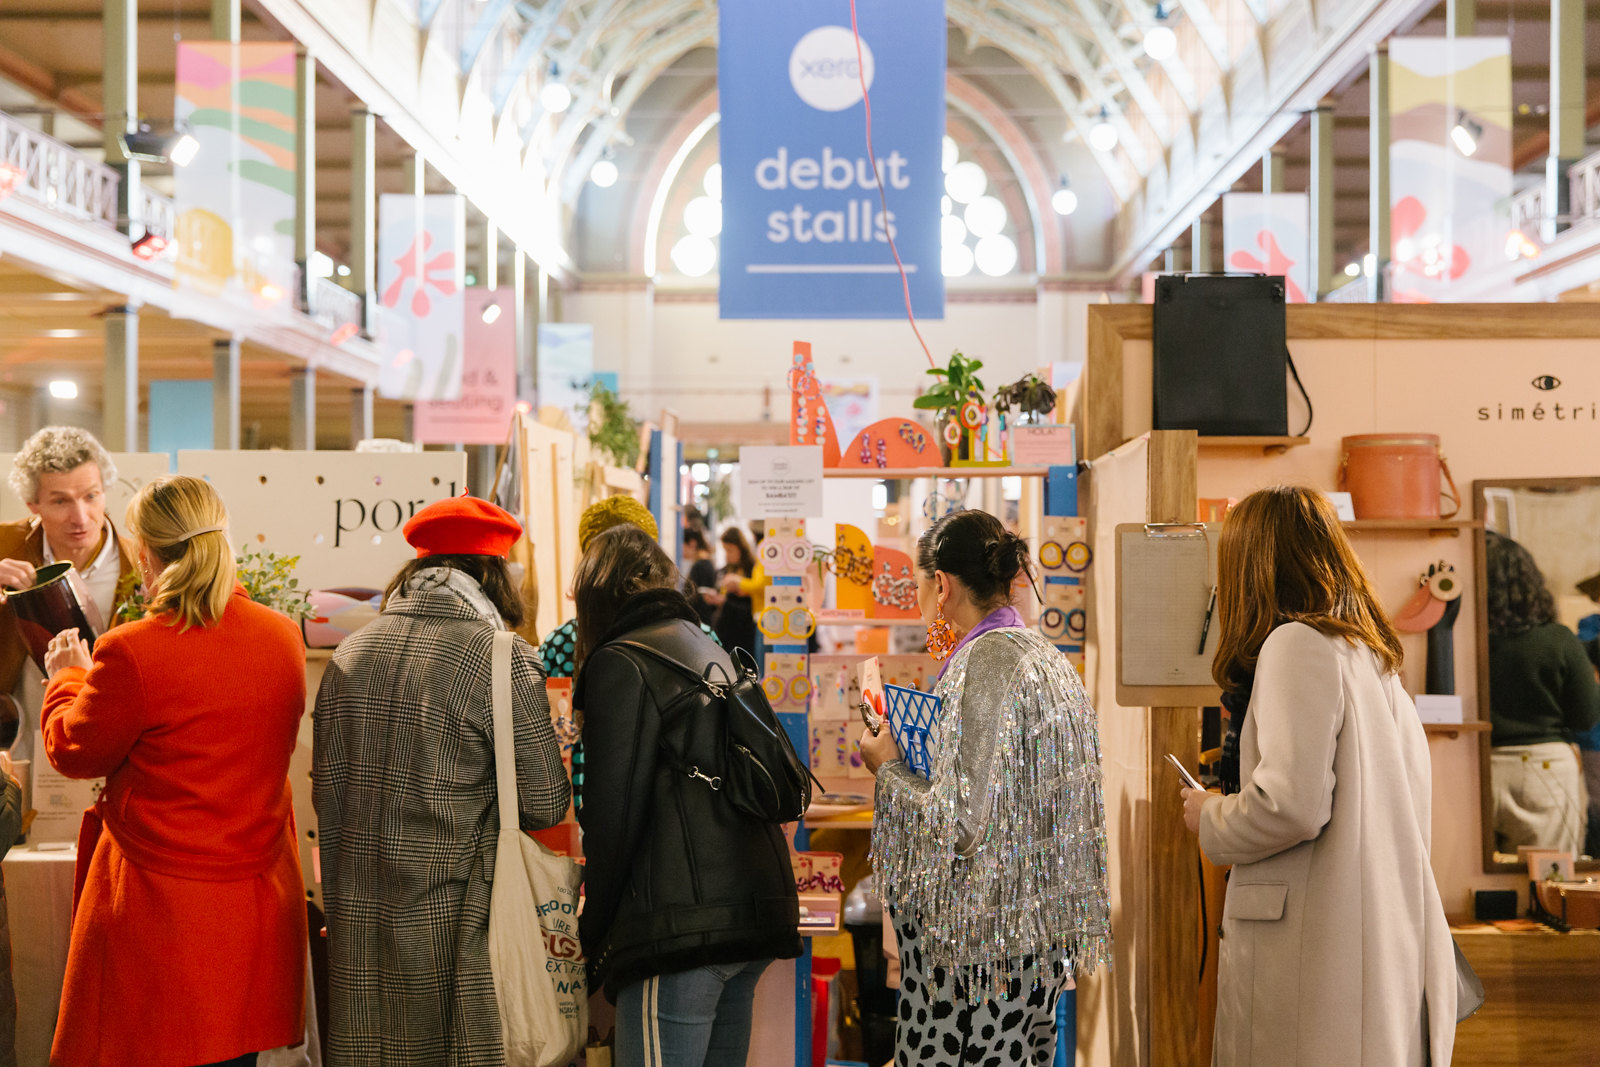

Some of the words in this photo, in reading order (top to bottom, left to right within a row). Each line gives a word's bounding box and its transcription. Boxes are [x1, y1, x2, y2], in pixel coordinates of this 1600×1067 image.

[798, 56, 864, 80] xero
[755, 147, 910, 190] debut
[767, 200, 898, 243] stalls
[1477, 402, 1596, 421] simétri
